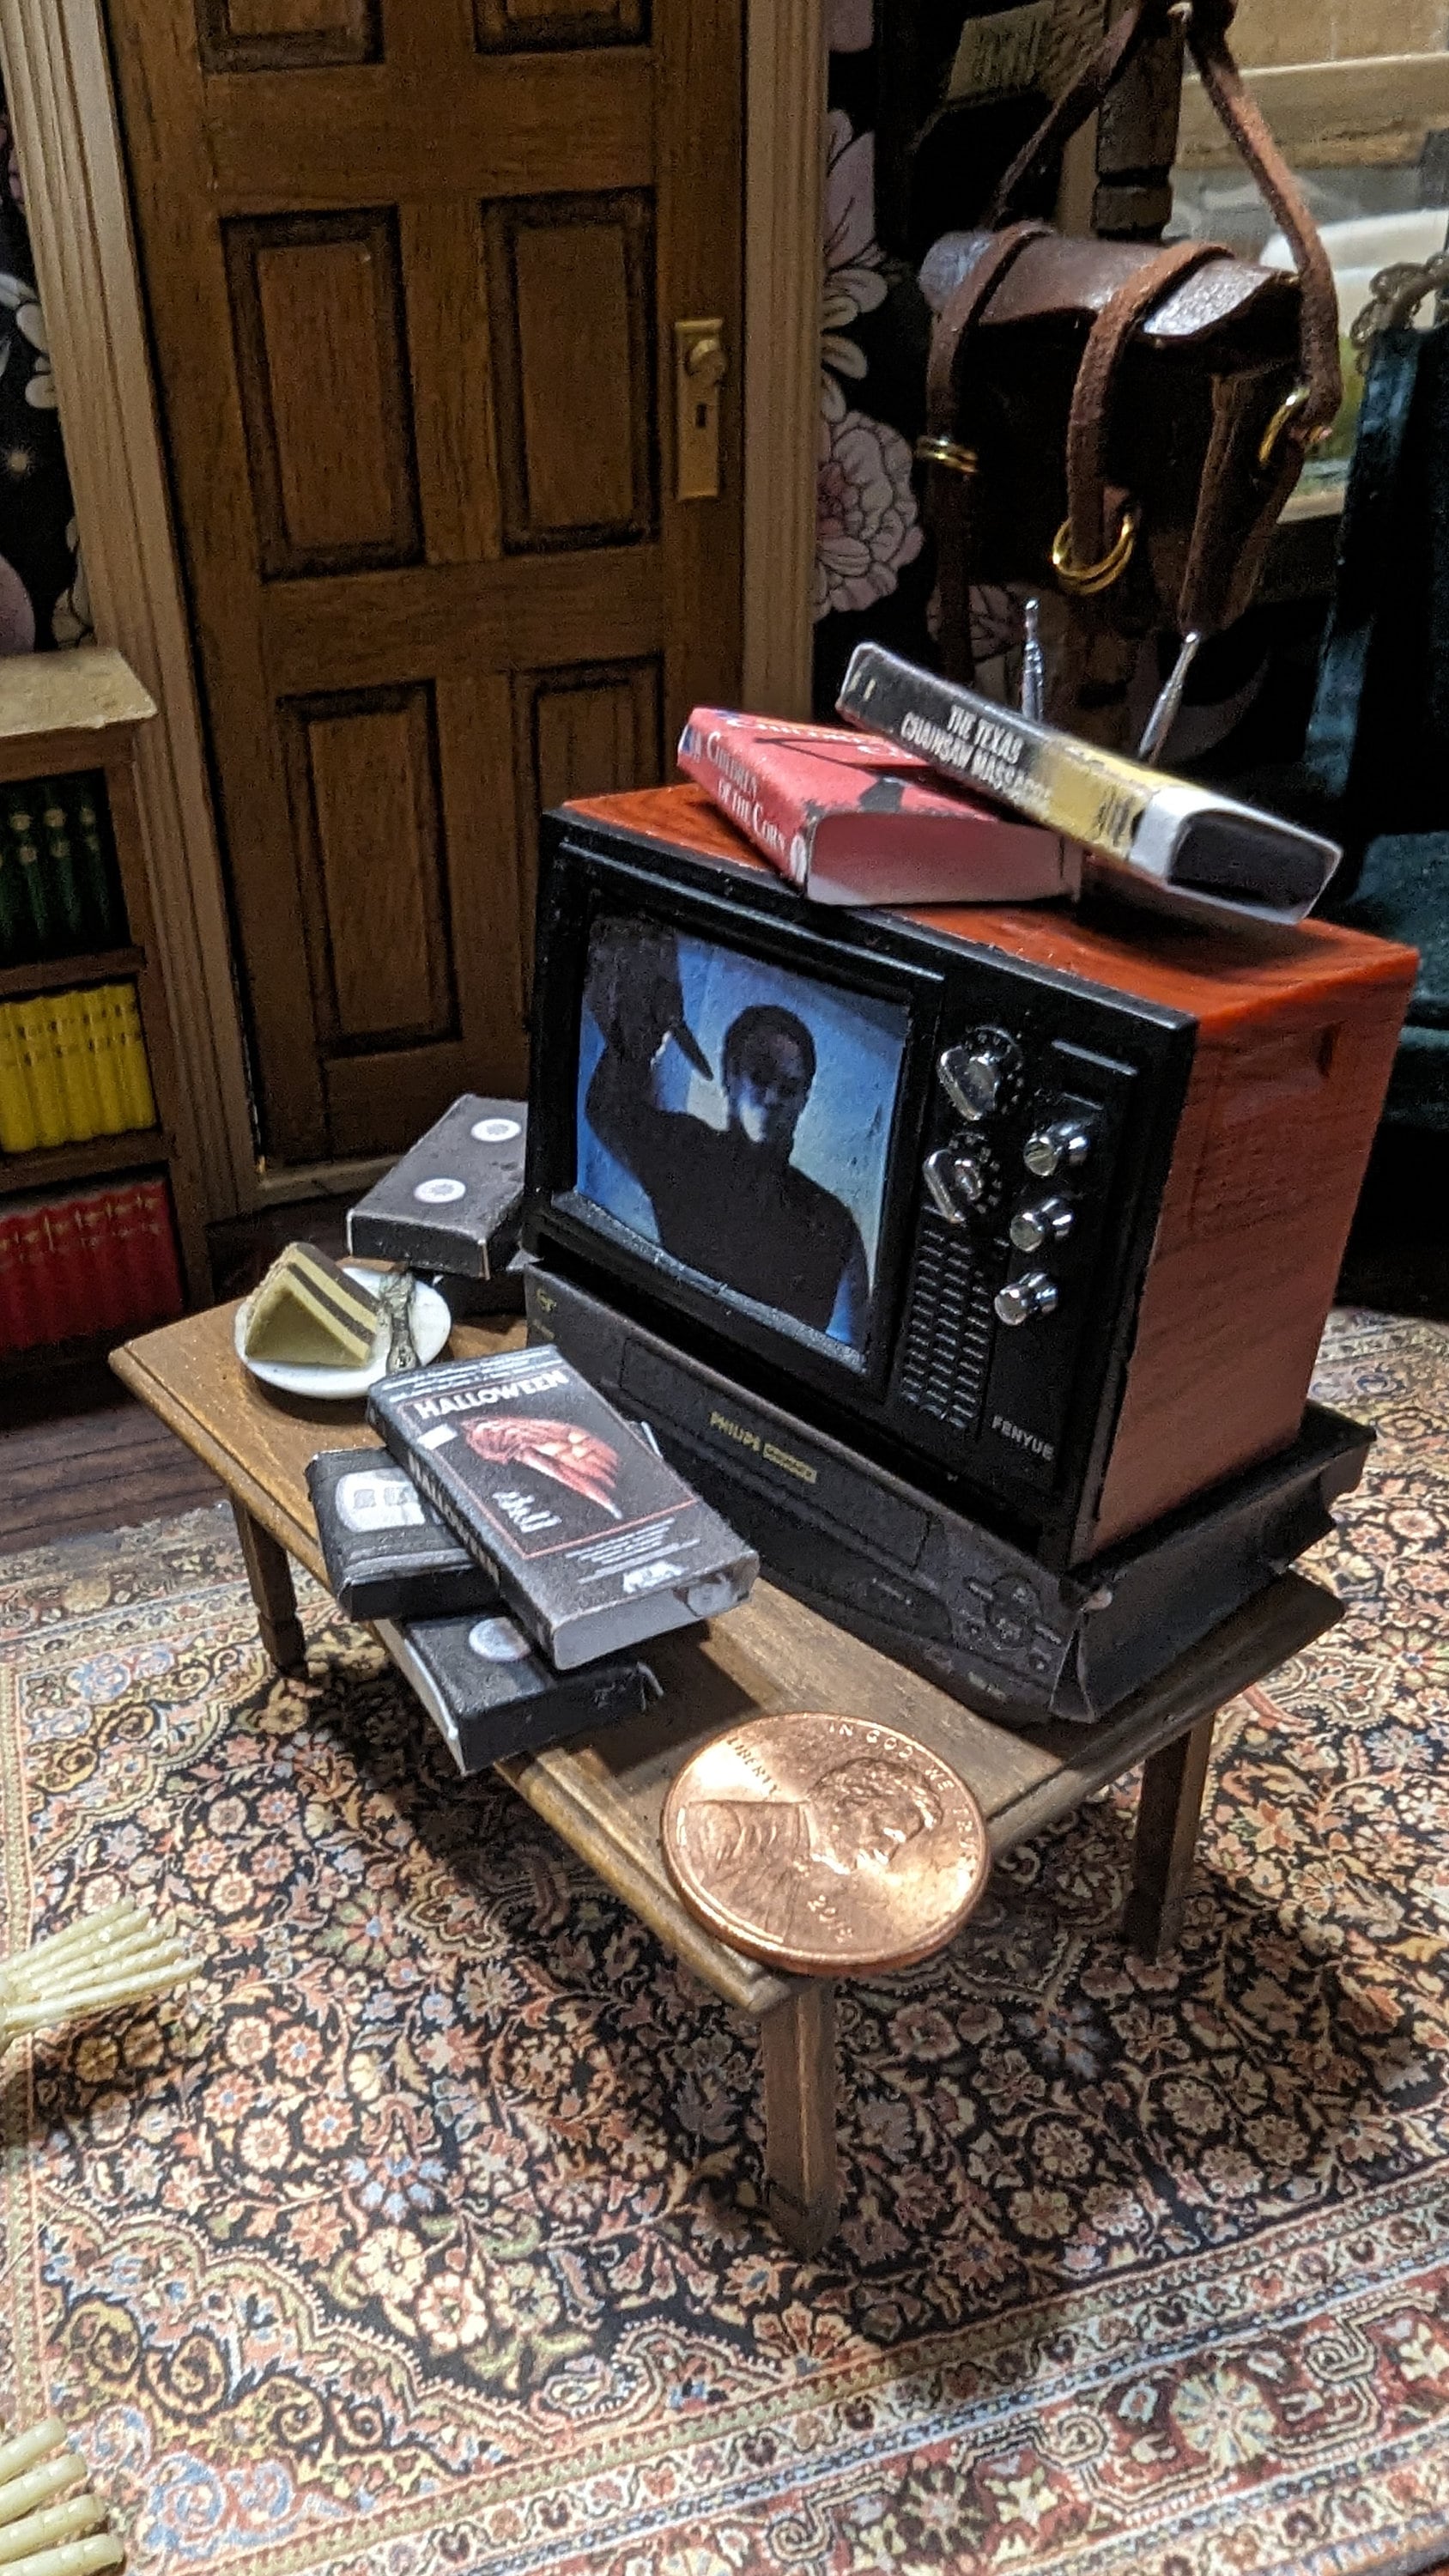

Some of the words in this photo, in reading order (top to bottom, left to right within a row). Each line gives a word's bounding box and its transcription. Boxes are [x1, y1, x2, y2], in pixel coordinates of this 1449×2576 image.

[900, 711, 976, 769] CHAINSAW
[971, 750, 1052, 817] MASSA
[947, 704, 977, 740] THE
[973, 718, 1025, 764] TEXAS
[413, 1369, 570, 1419] HALLOWEEN
[709, 1410, 761, 1452] PHILIPS
[991, 1415, 1055, 1461] FENYUE
[725, 1735, 780, 1799] LIBERTY
[829, 1722, 854, 1738] IN
[864, 1728, 915, 1759] GOD
[952, 1803, 980, 1880] TRU
